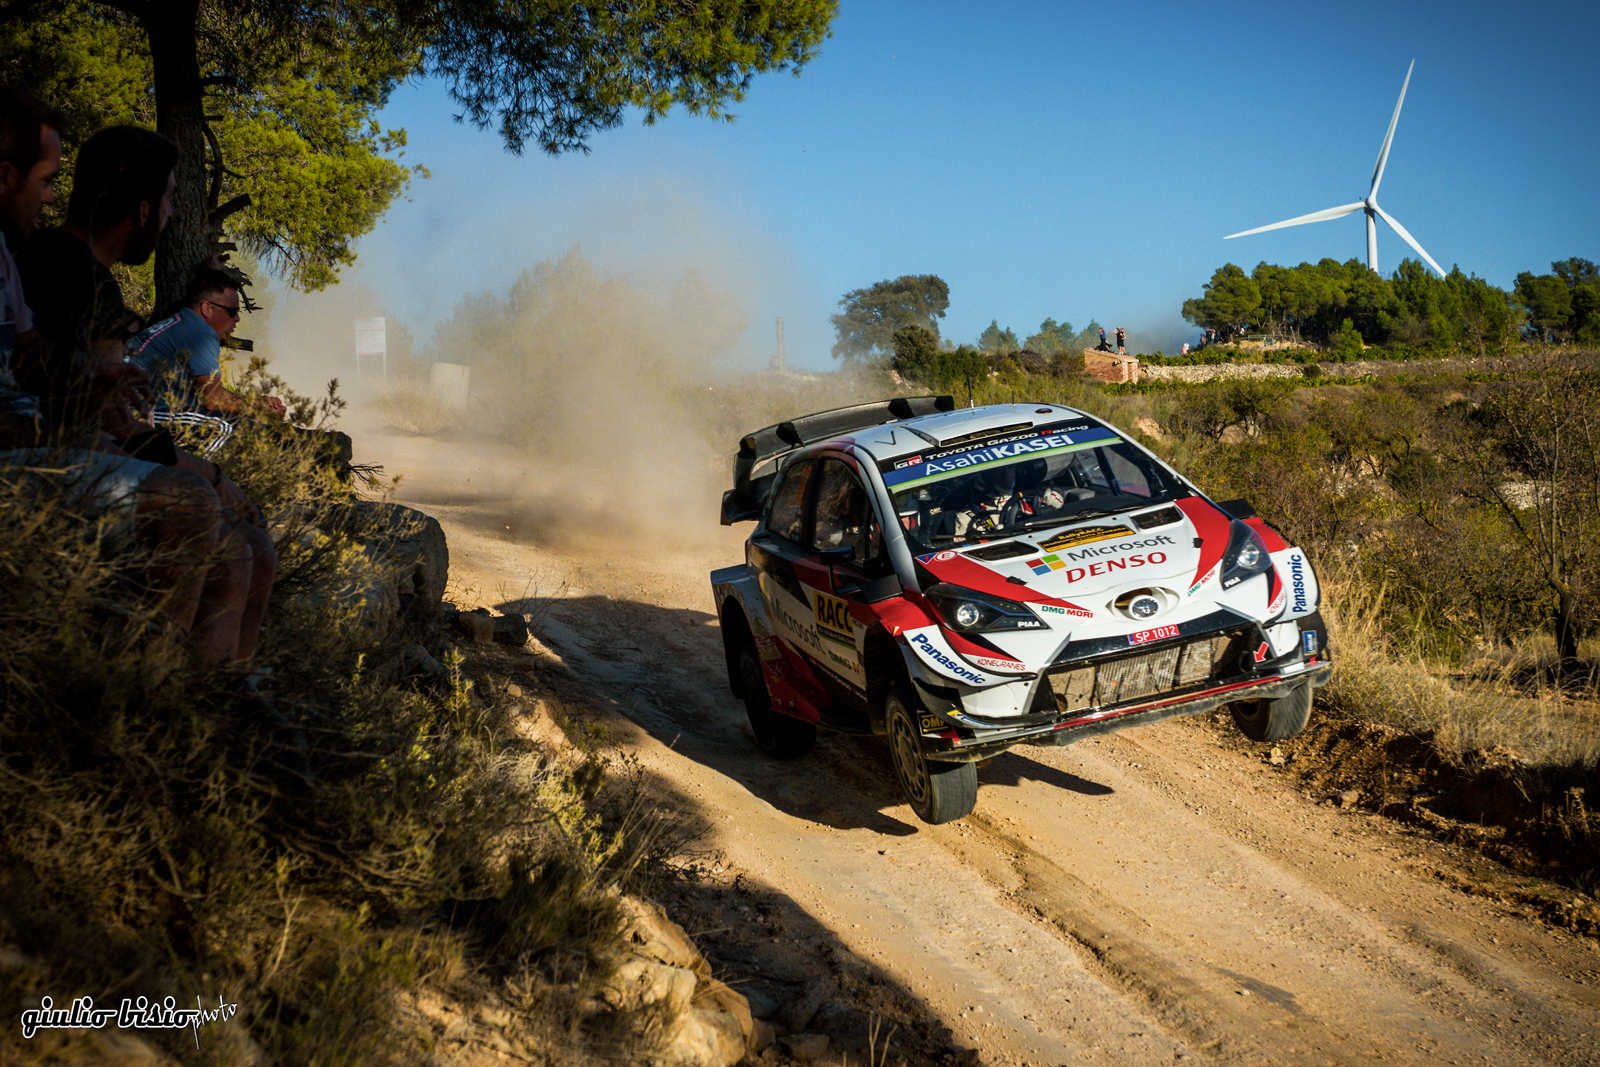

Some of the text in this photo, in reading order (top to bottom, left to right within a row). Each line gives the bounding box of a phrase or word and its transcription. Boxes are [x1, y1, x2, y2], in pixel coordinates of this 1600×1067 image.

[925, 424, 1089, 460] TOYOTA GAZOO Racing
[1067, 534, 1177, 563] Microsoft
[1065, 551, 1168, 584] DENSO
[1287, 554, 1308, 613] Panasonic
[771, 597, 826, 655] Microsoft
[816, 594, 854, 633] RACC
[1041, 605, 1094, 618] DMG MORI
[1135, 625, 1177, 642] SP 1012
[911, 633, 986, 684] Panasonic
[977, 657, 1026, 671] KONECRANES
